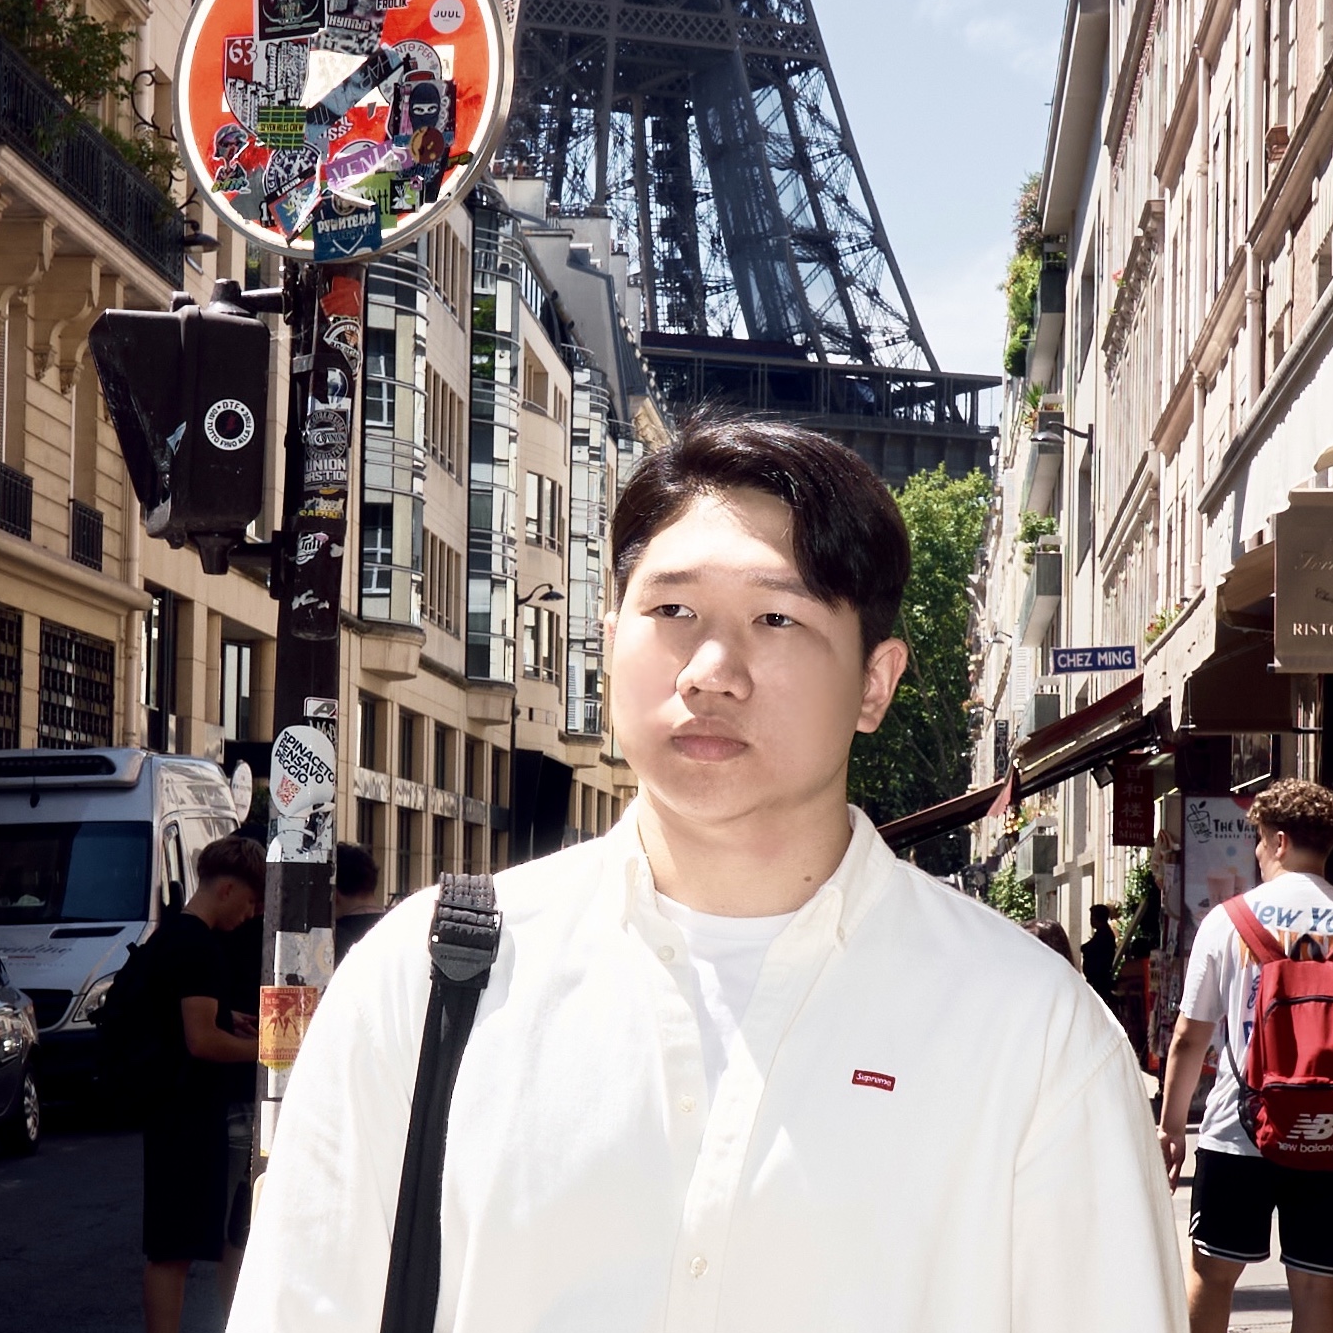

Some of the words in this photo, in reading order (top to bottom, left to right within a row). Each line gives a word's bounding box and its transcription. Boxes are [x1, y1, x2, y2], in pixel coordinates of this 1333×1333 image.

[434, 10, 461, 18] JUUL
[417, 44, 434, 61] PER
[222, 401, 240, 409] DTF
[207, 421, 220, 443] TUTTO
[238, 430, 251, 444] ALLA
[306, 458, 346, 471] UNION
[1057, 652, 1092, 668] CHEZ
[1097, 650, 1133, 667] MING
[275, 750, 309, 787] PEGGIO.
[279, 739, 324, 785] PENSAVO
[1118, 819, 1145, 829] Chez
[1118, 830, 1146, 842] Ming
[856, 1072, 892, 1087] Supreme
